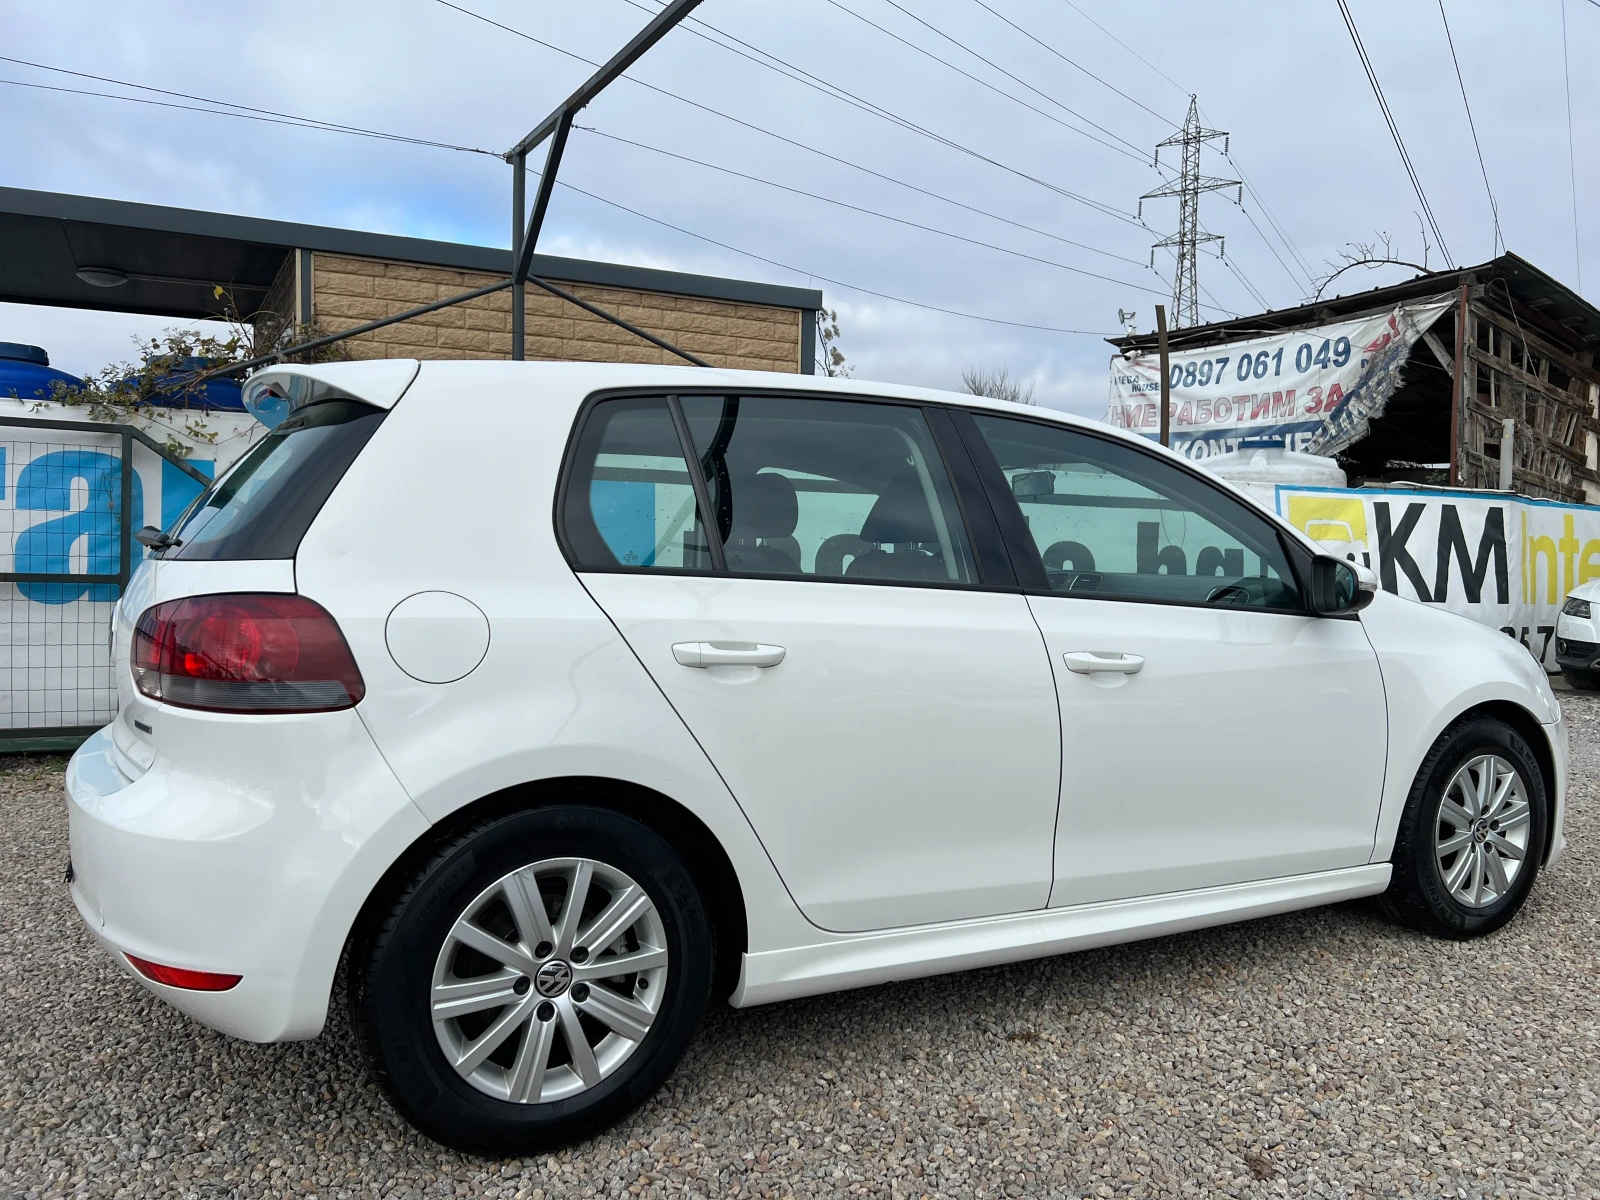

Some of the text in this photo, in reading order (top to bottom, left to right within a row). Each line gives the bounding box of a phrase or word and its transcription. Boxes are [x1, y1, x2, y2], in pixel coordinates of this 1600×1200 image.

[1169, 336, 1351, 389] 0897 061 049
[1110, 403, 1157, 428] НИЕ
[1305, 383, 1345, 414] ЗА
[1373, 501, 1510, 604] KM
